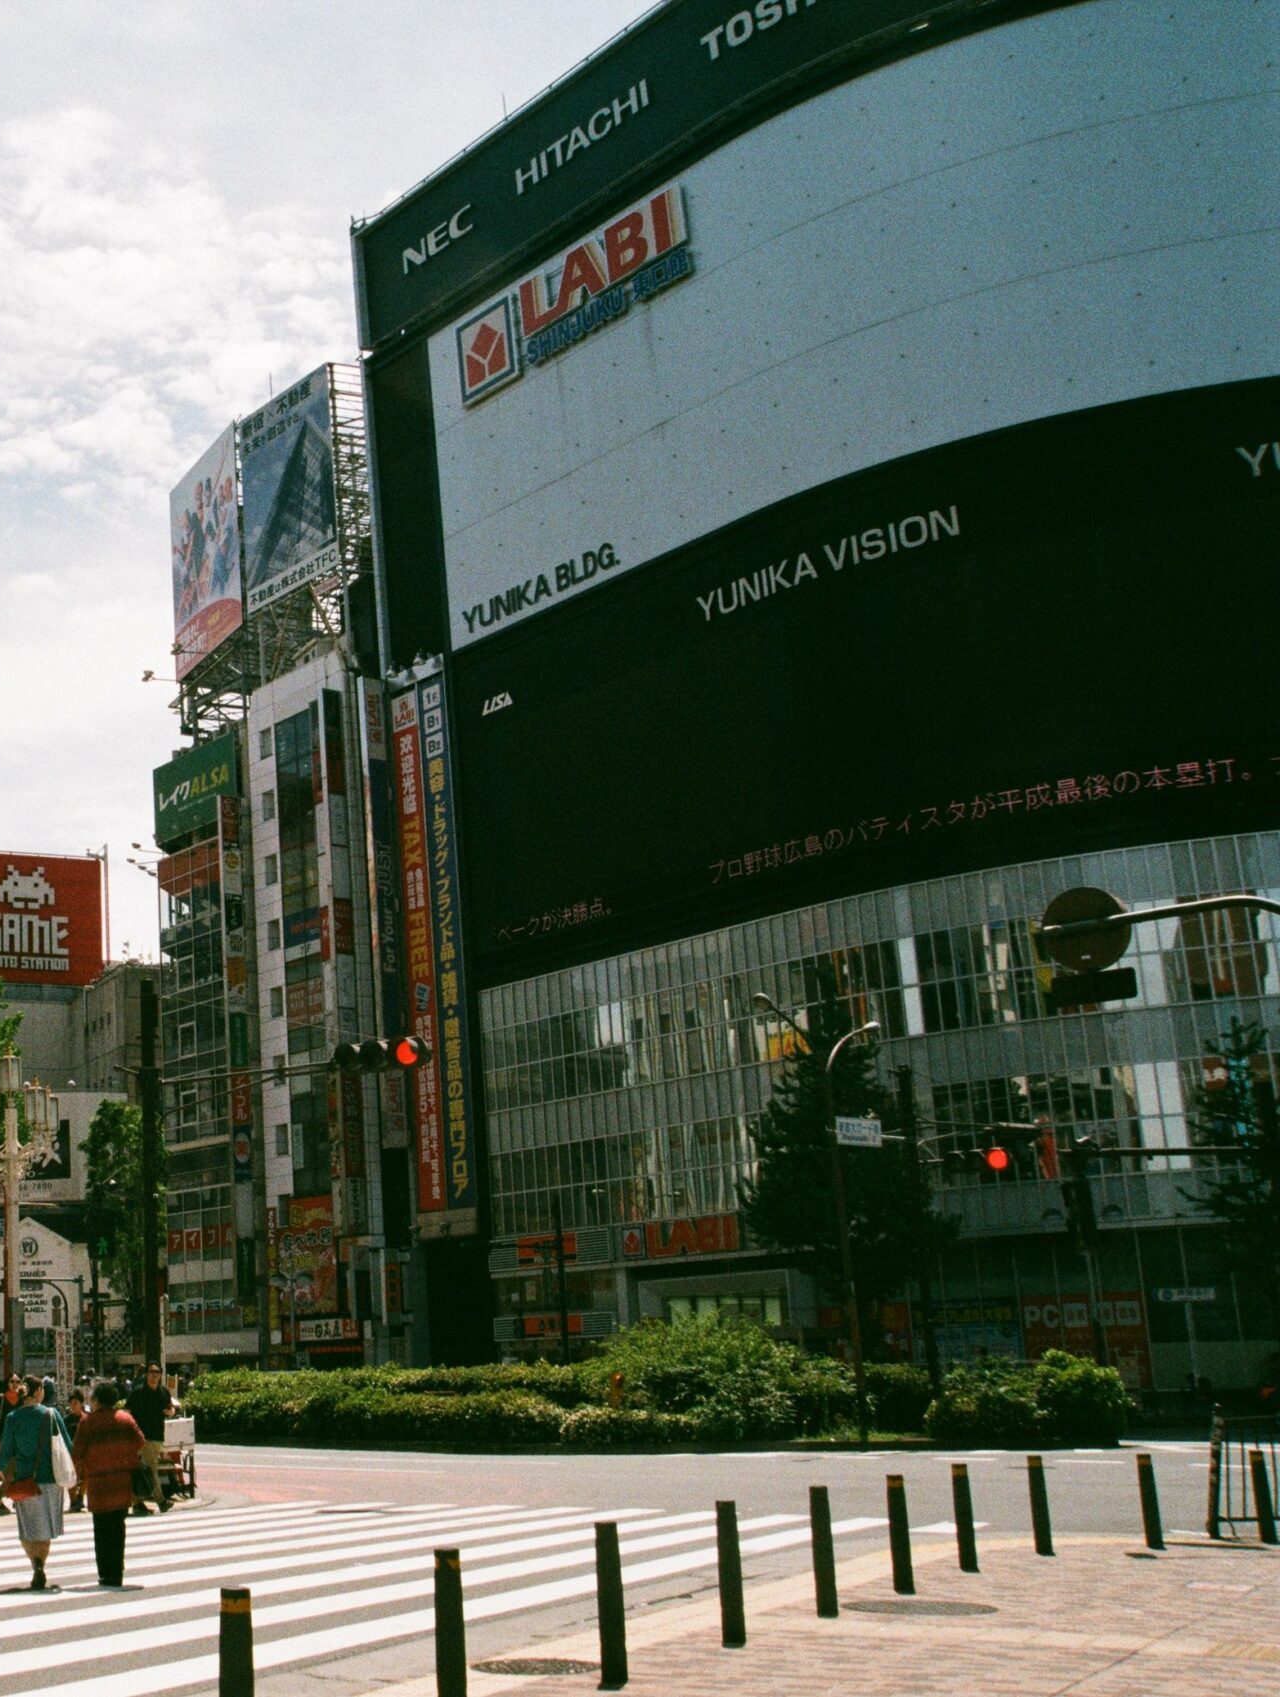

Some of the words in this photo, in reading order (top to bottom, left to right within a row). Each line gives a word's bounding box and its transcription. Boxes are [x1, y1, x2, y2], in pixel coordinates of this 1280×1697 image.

[700, 0, 817, 61] TOS
[514, 78, 650, 195] HITACHI
[402, 204, 474, 274] NEC
[518, 188, 677, 338] LABI
[526, 285, 626, 365] SHINJUKU
[1235, 441, 1280, 478] Y
[462, 573, 552, 634] YUNIKA
[555, 542, 622, 594] BLDG.
[696, 552, 819, 622] YUNIKA
[823, 505, 962, 572] VISION
[482, 690, 514, 717] LISA
[20, 957, 69, 972] STATION
[645, 1213, 739, 1259] LABI
